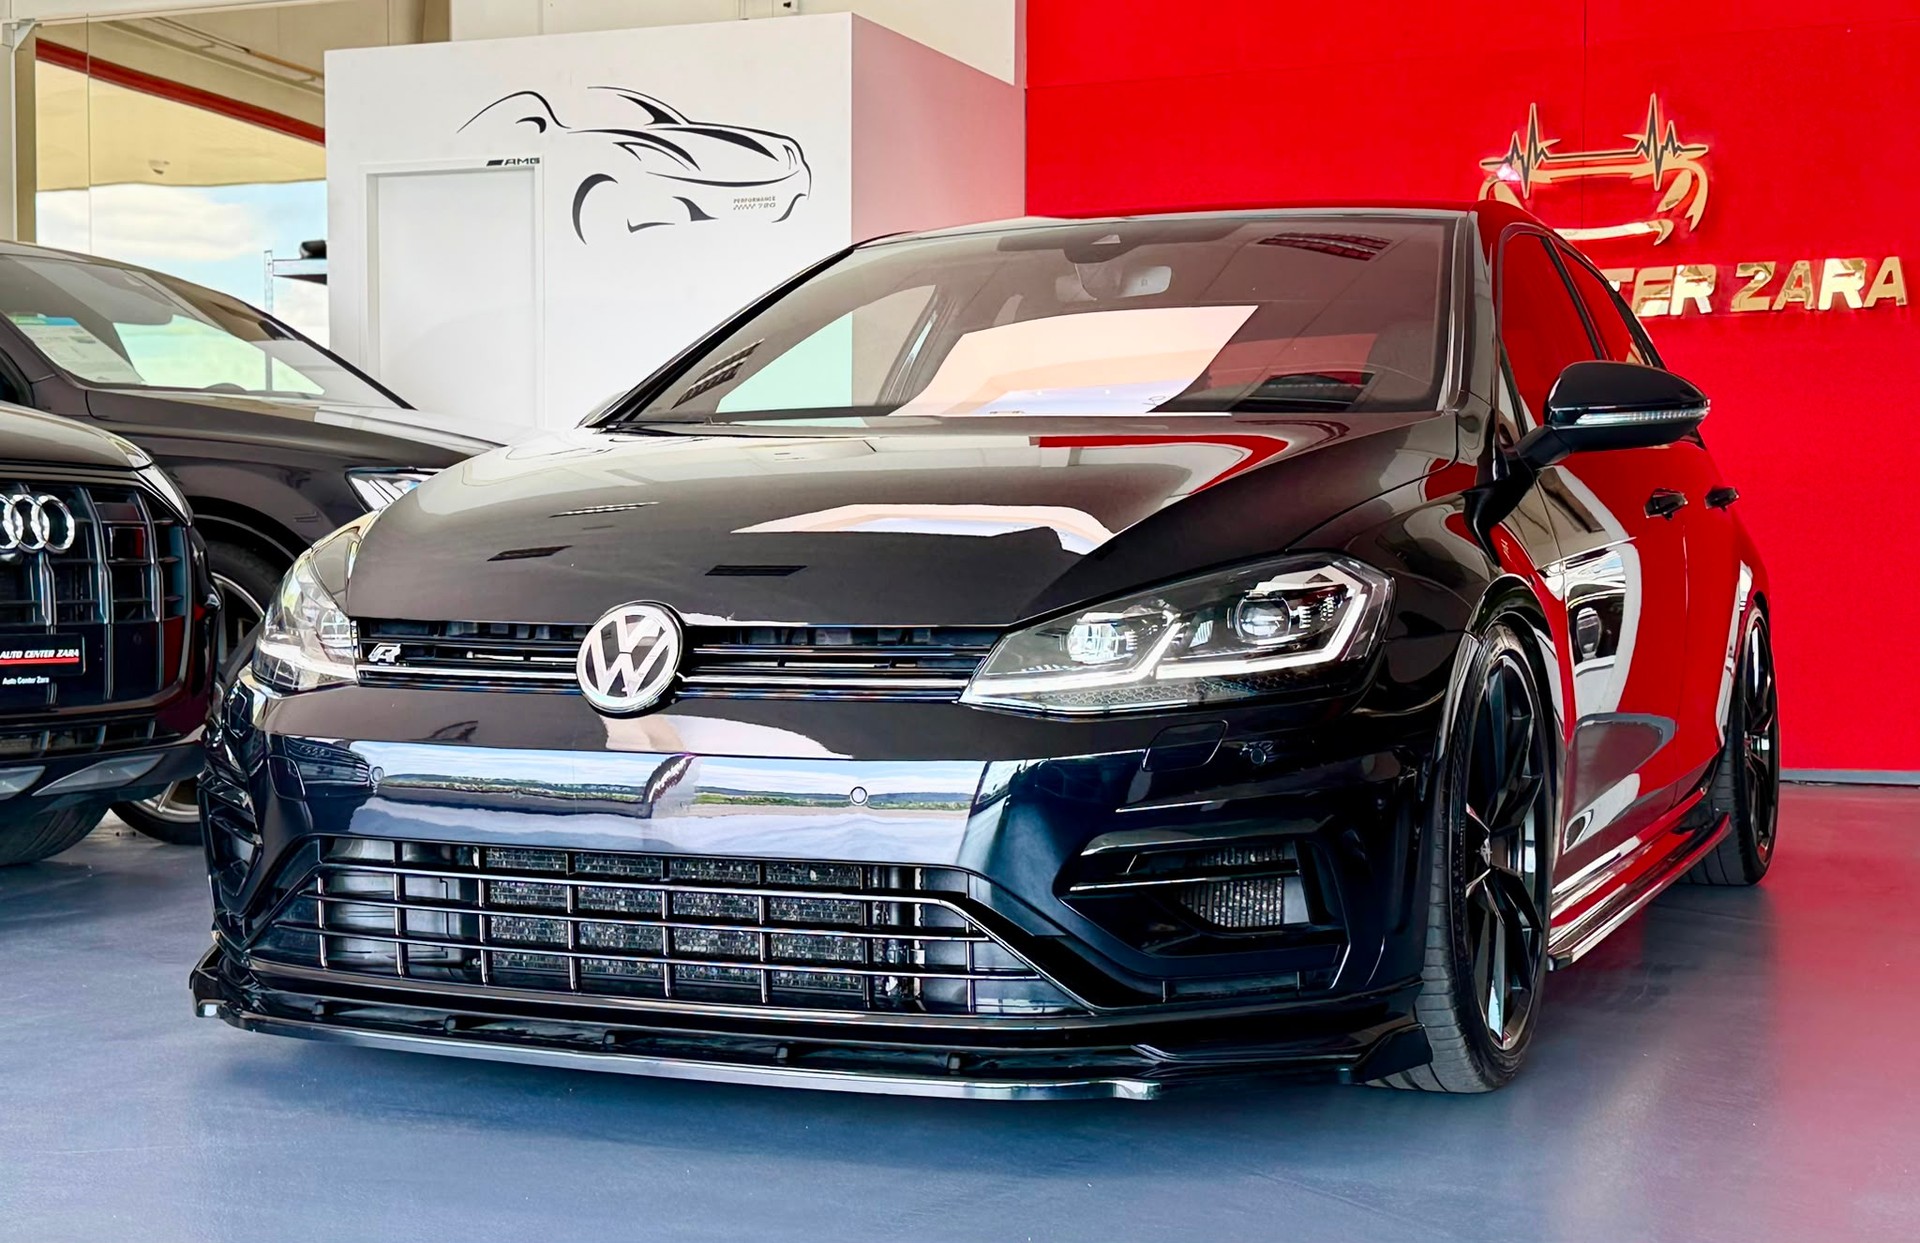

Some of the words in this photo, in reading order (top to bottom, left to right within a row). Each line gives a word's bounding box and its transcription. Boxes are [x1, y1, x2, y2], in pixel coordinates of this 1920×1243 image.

[504, 157, 541, 166] AMG
[1730, 256, 1908, 312] ZARA
[24, 650, 55, 658] CENTER
[56, 649, 80, 658] ZARA
